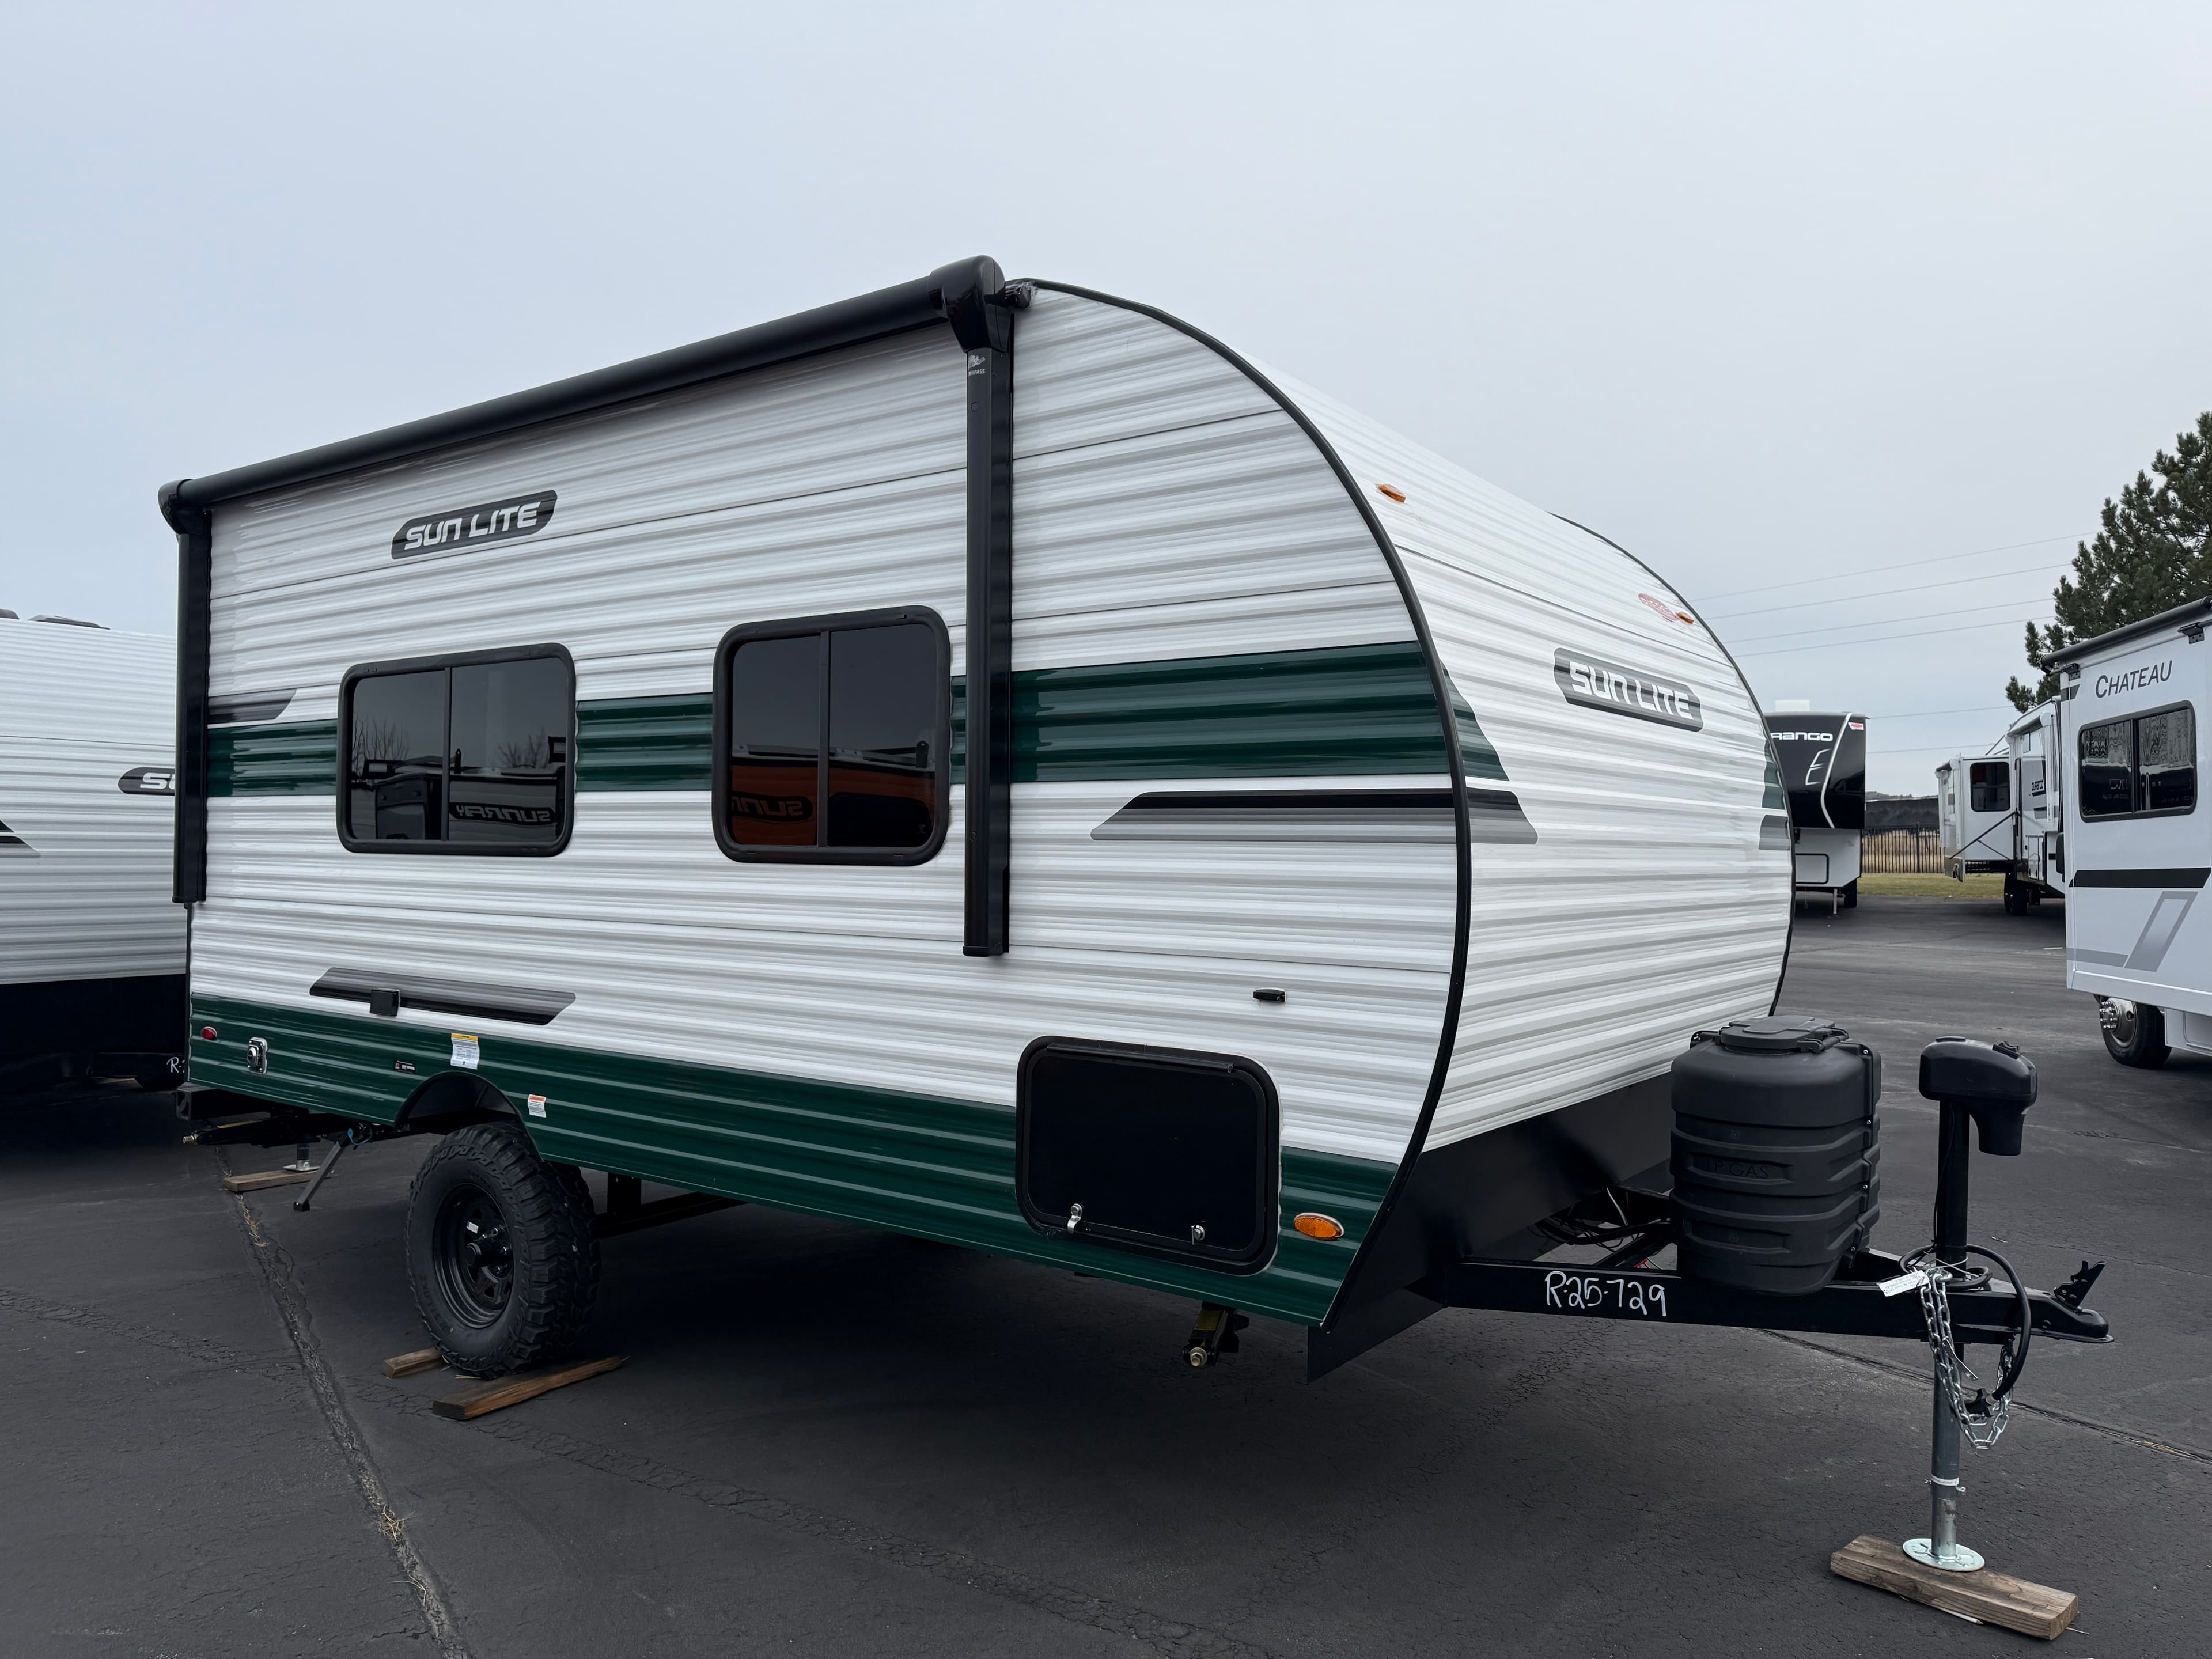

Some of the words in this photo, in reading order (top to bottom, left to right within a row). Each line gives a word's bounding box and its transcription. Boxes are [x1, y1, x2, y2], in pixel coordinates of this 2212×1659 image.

[404, 517, 463, 550] SUN
[468, 501, 541, 538] LITE
[1569, 661, 1632, 705] SUN
[1634, 679, 1694, 720] LITE
[1728, 1160, 1769, 1179] GAS
